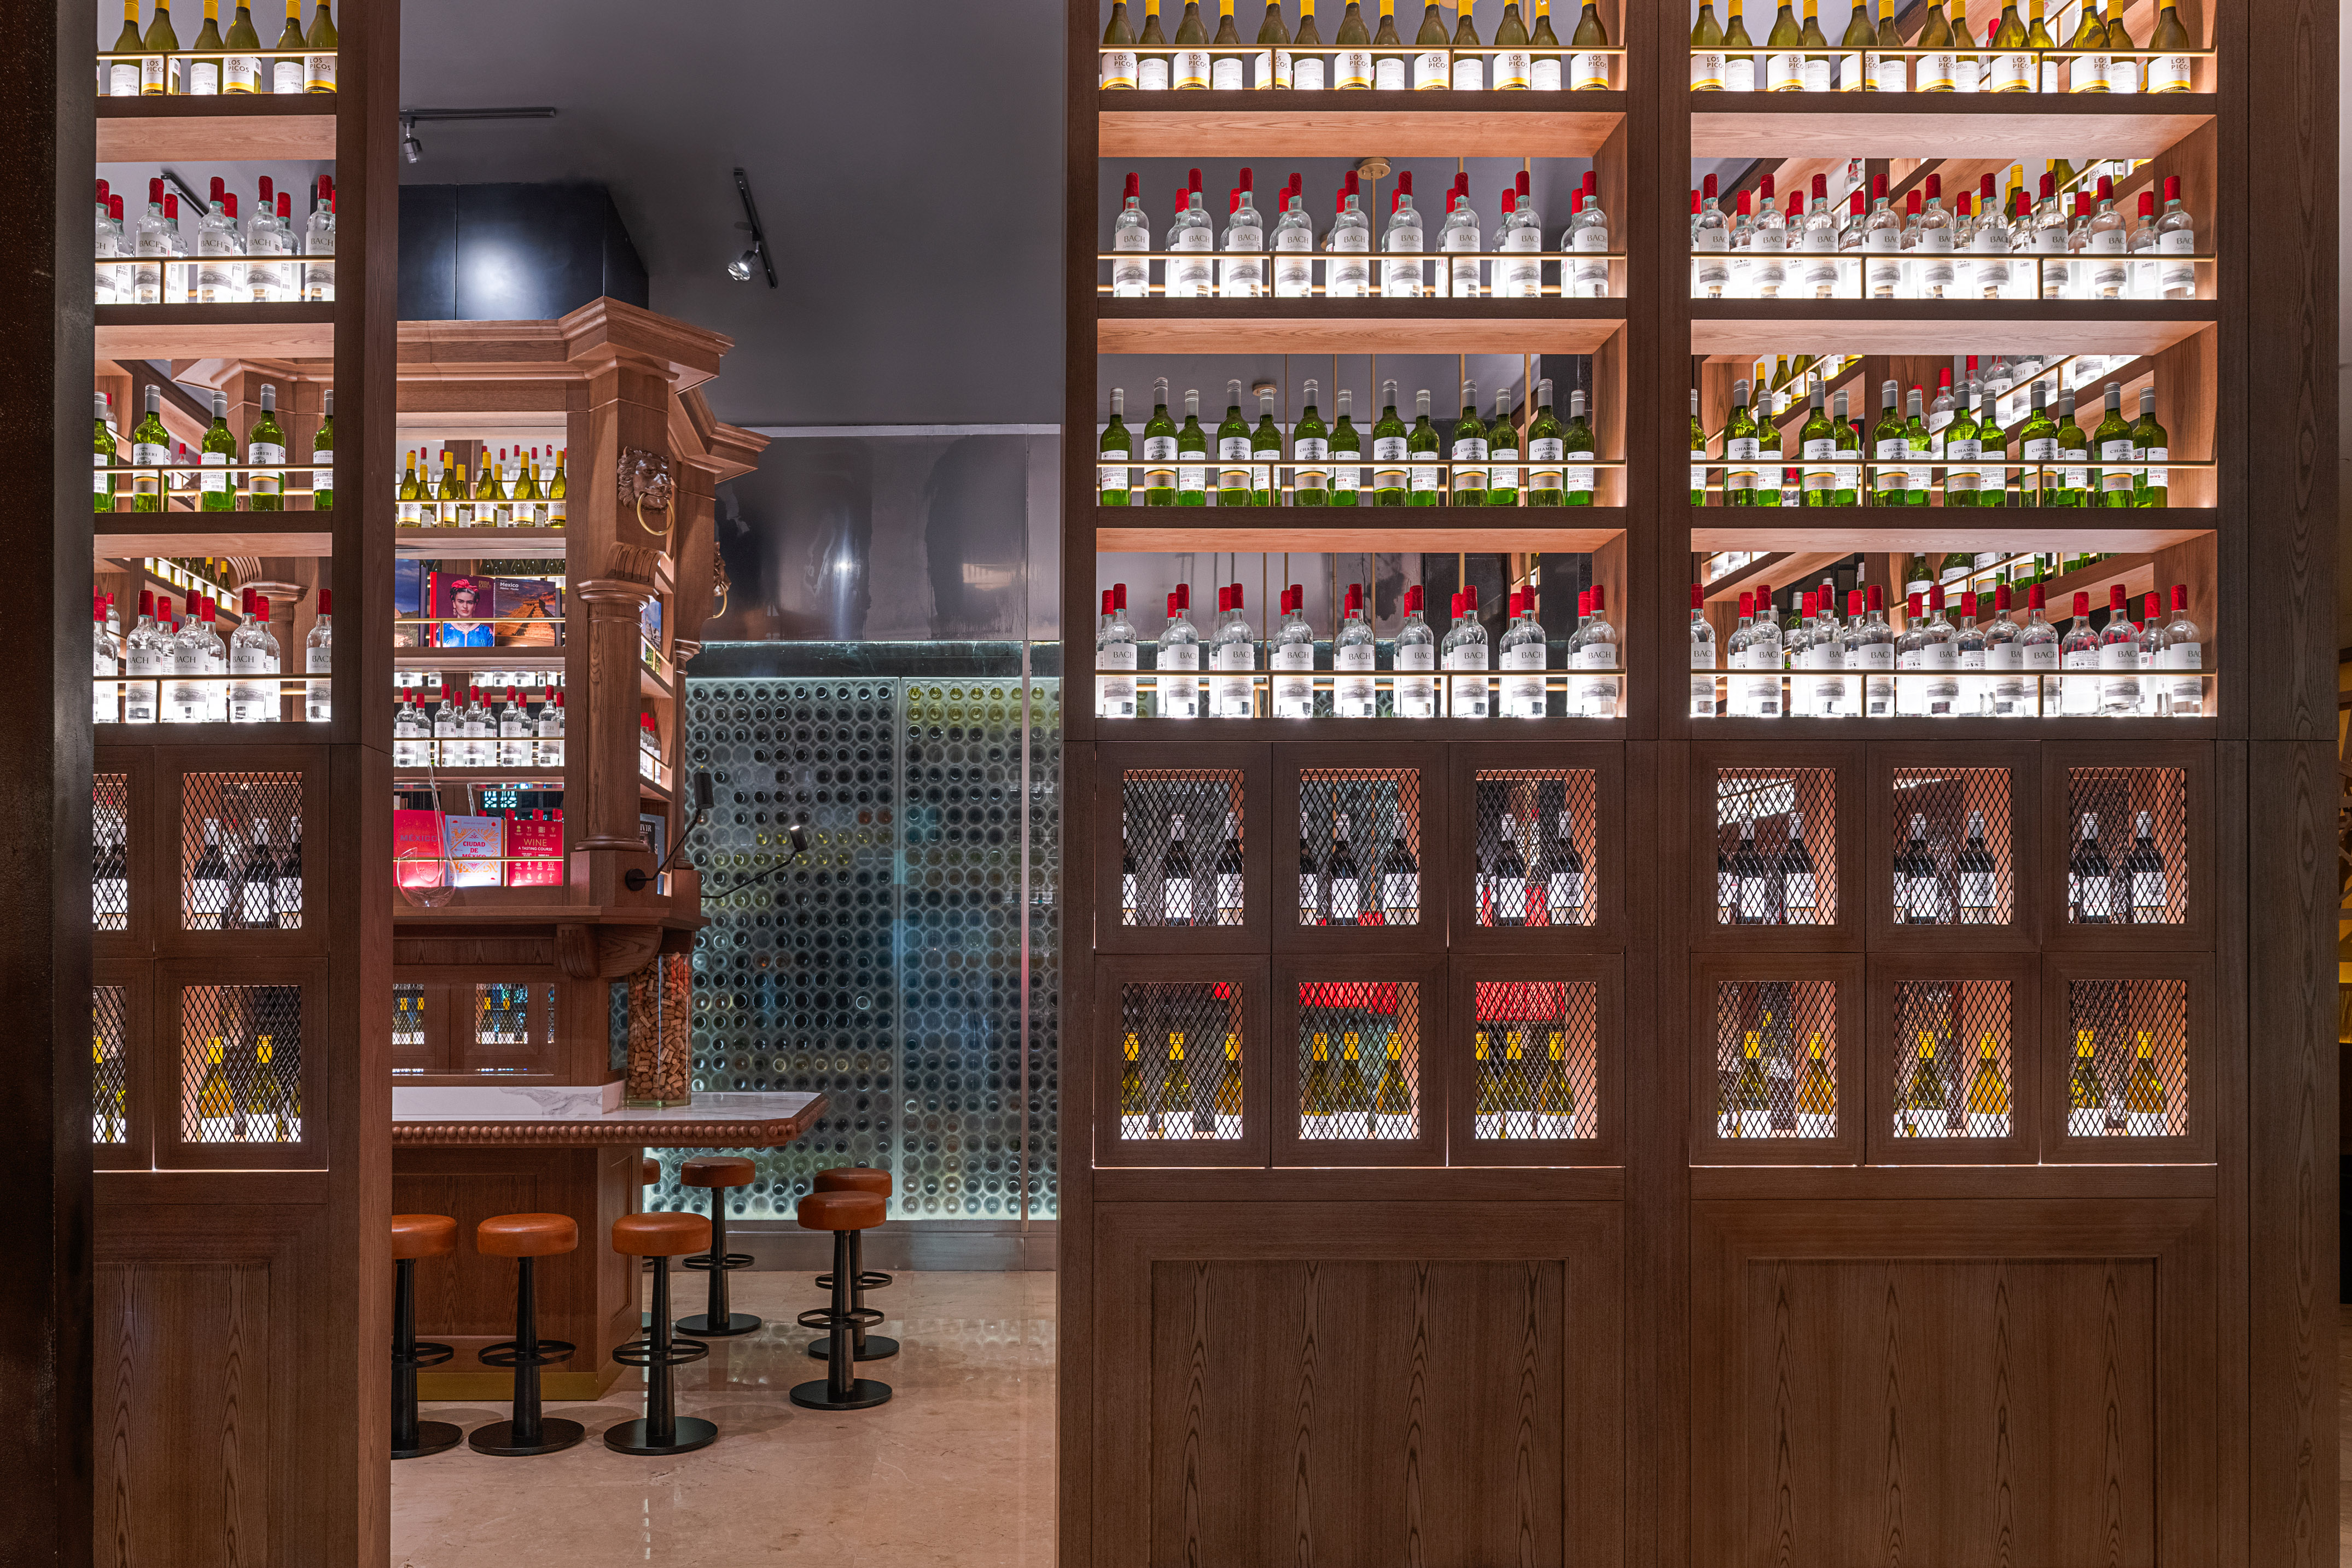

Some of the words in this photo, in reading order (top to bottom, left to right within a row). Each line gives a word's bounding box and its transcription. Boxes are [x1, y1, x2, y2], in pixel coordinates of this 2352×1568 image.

[1114, 60, 1133, 68] PICOS
[1189, 60, 1207, 69] PICOS
[1123, 235, 1145, 243] BACH
[1189, 235, 1210, 243] BACH
[1238, 234, 1259, 242] BACH
[1288, 235, 1309, 244] BACH
[1344, 235, 1365, 243] BACH
[1401, 234, 1421, 243] BACH
[1459, 234, 1478, 243] BACH
[1587, 234, 1607, 243] BACH
[1763, 236, 1784, 244] BACH
[201, 240, 223, 248] BACH
[249, 238, 271, 247] BACH
[311, 238, 333, 247] BACH
[2013, 369, 2025, 377] ACH
[1464, 651, 1486, 660] BACH
[640, 824, 651, 832] IVIR
